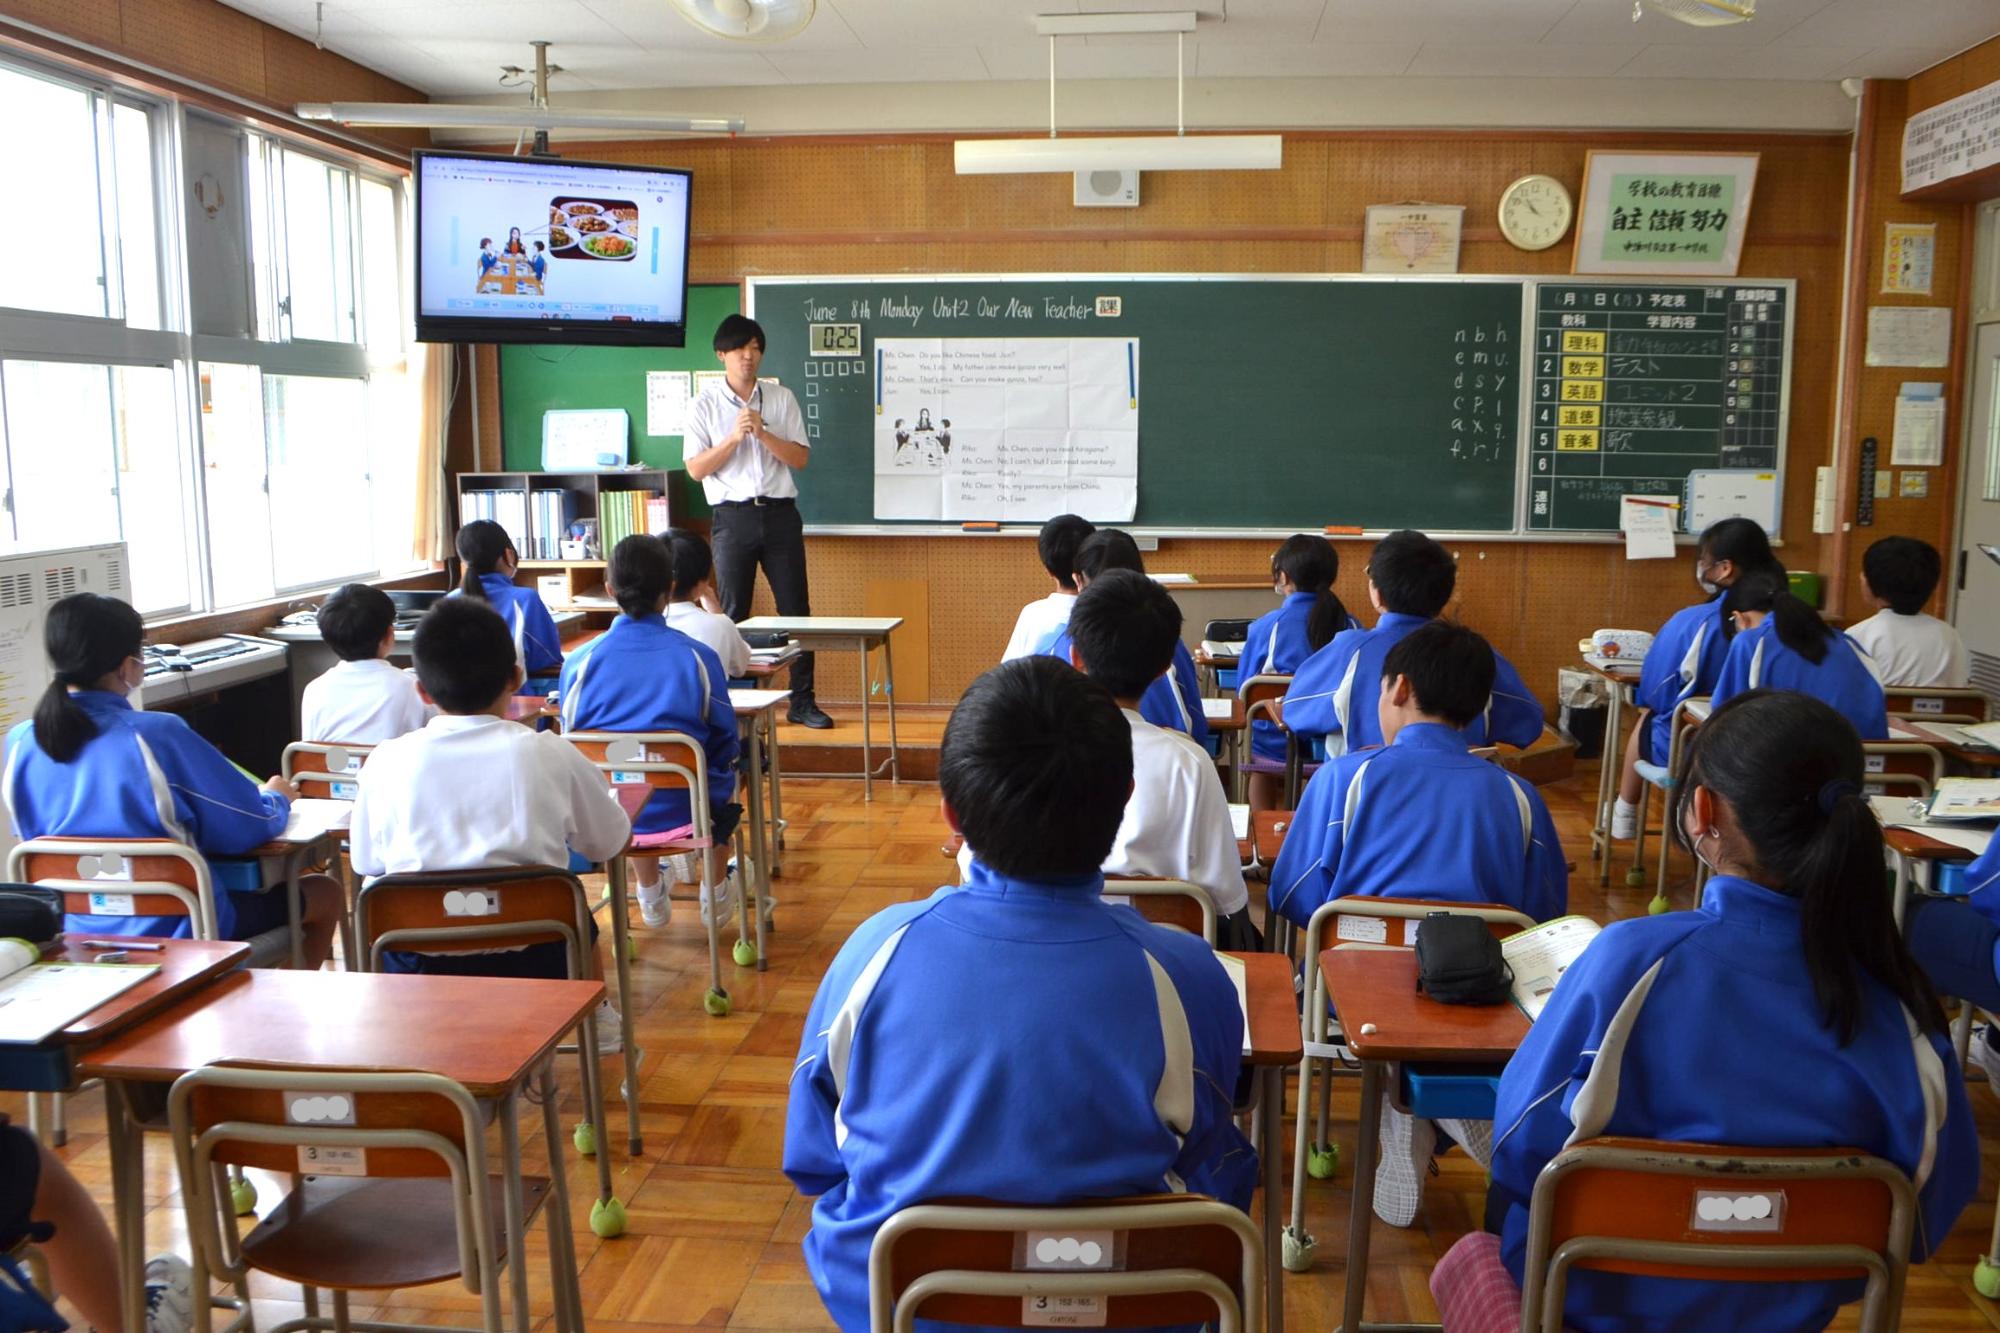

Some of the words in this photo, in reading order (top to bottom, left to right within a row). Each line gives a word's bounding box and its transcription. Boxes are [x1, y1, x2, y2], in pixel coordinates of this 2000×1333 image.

[1612, 206, 1643, 231] 自主
[1649, 208, 1687, 232] 信頼
[1690, 208, 1728, 232] 努力
[1649, 294, 1686, 307] 予定表
[804, 298, 837, 321] June
[851, 299, 870, 319] 8th
[880, 295, 924, 328] Monday
[977, 296, 1000, 318] Our
[1005, 297, 1034, 319] New
[1043, 296, 1093, 319] Teacher
[1561, 314, 1586, 327] 教科
[1647, 315, 1696, 328] 学習内容
[1545, 335, 1552, 347] 1
[1568, 336, 1599, 350] 理科
[1455, 351, 1464, 365] e
[1473, 351, 1488, 364] m
[1543, 359, 1551, 372] 2
[1568, 361, 1598, 375] 数学
[1612, 357, 1660, 375] テスト
[1454, 372, 1463, 389] d
[1475, 374, 1485, 388] s
[1494, 375, 1505, 391] y
[1542, 384, 1550, 397] 3
[1567, 385, 1598, 399] 英語
[1453, 396, 1464, 410] c
[1541, 409, 1549, 421] 4
[1563, 410, 1594, 424] 道徳
[1540, 433, 1548, 446] 5
[1563, 434, 1593, 448] 音楽
[1538, 458, 1547, 471] 6
[1534, 490, 1548, 514] 連絡
[308, 1147, 317, 1160] 3
[1036, 1296, 1048, 1309] 3
